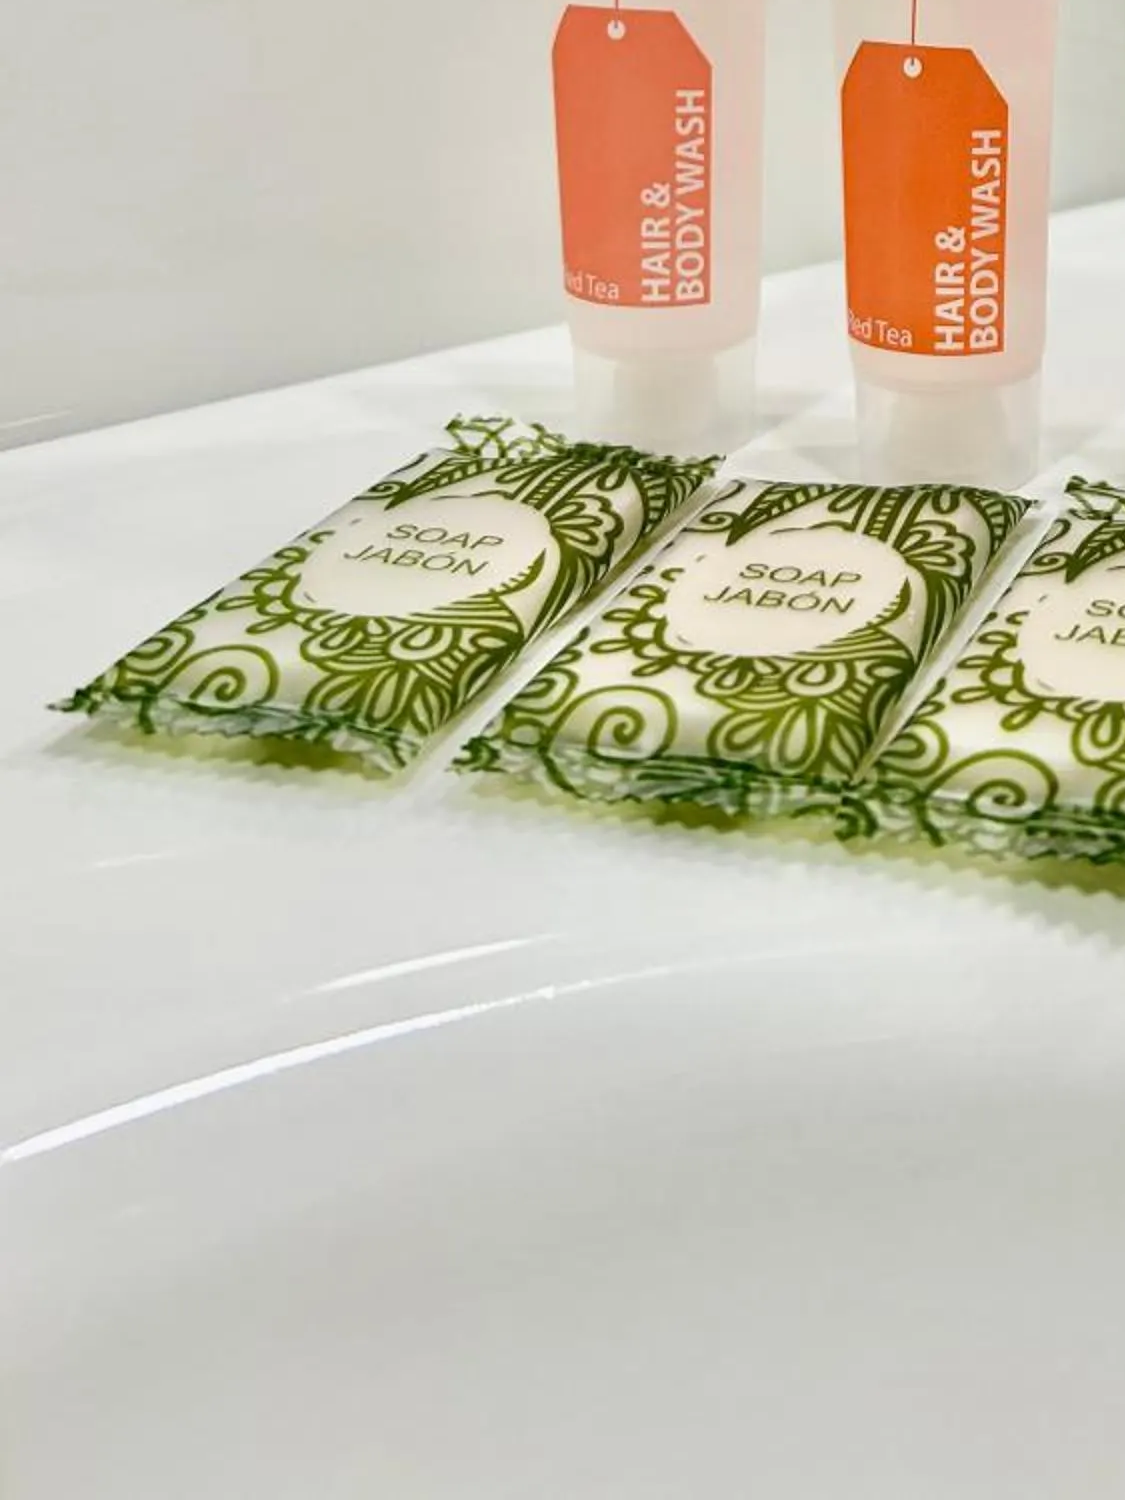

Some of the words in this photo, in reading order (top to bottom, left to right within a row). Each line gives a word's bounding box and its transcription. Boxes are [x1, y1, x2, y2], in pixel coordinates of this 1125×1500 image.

[675, 88, 705, 196] WASH
[640, 182, 671, 208] &
[971, 129, 1001, 240] WASH
[675, 203, 705, 301] BODY
[934, 226, 966, 254] &
[640, 217, 671, 303] HAIR
[585, 273, 619, 300] Tea
[969, 247, 999, 350] BODY
[934, 262, 965, 351] HAIR
[874, 319, 913, 348] Tea
[386, 524, 504, 550] SOAP
[344, 545, 489, 576] JABÓN
[739, 563, 862, 588] SOAP
[703, 586, 855, 615] JABÓN
